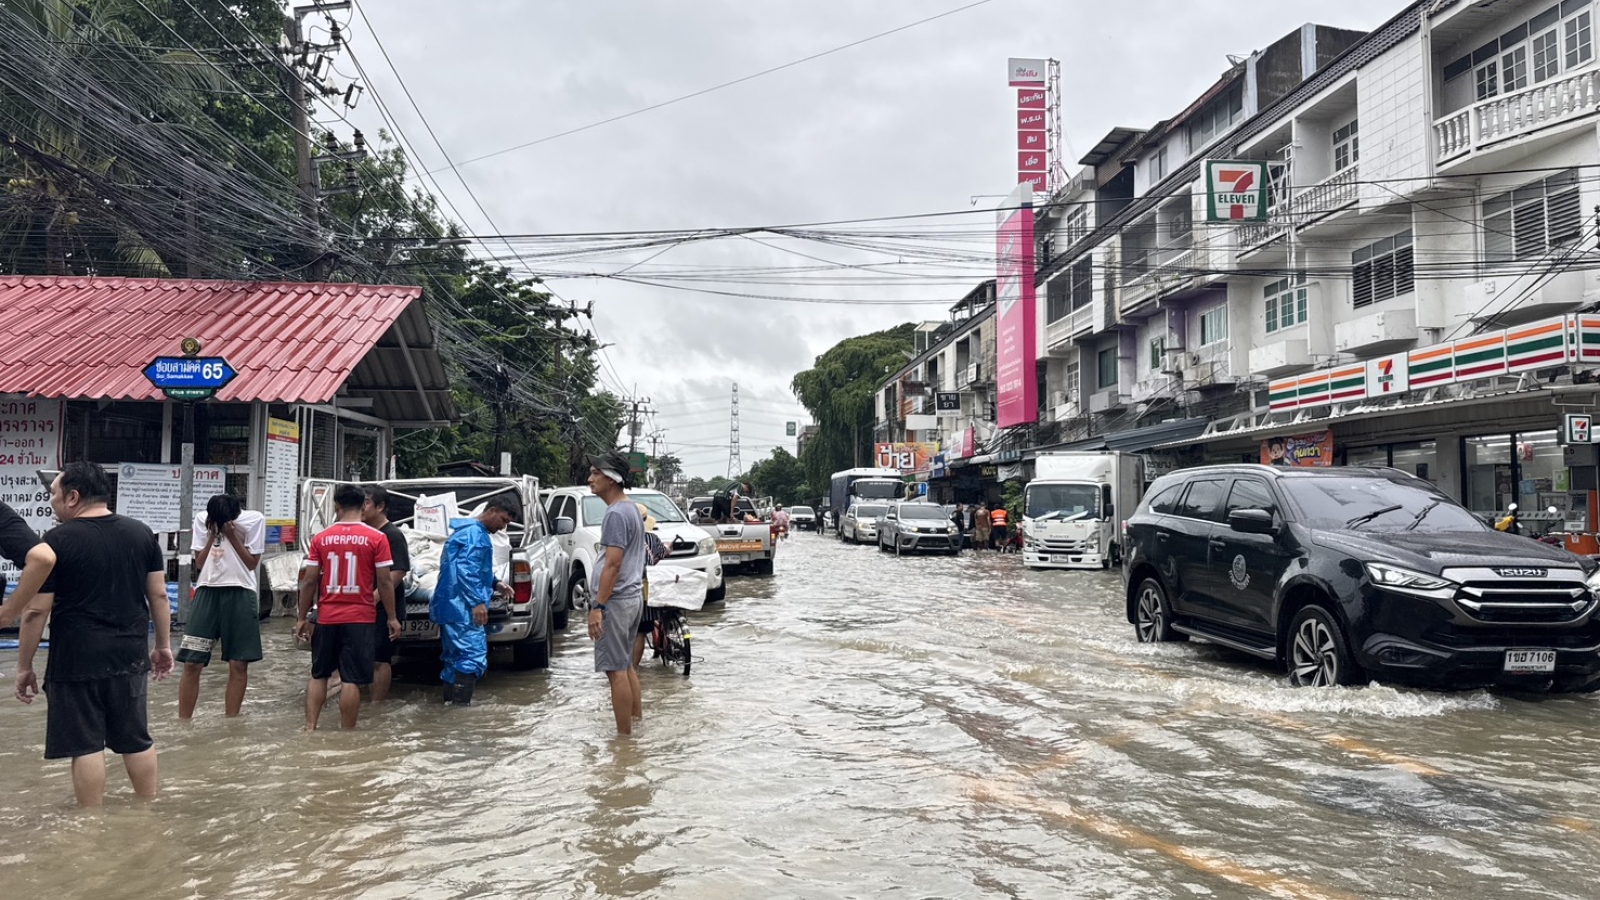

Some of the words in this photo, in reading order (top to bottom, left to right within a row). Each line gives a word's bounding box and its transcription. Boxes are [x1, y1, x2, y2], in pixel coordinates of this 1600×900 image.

[1019, 92, 1043, 103] ประกัน
[1020, 114, 1043, 125] พ.ร.บ.
[1218, 170, 1254, 220] 7
[202, 363, 223, 380] 65
[1378, 358, 1393, 392] 7
[0, 401, 36, 414] ะกาศ
[0, 419, 54, 432] รจราจร
[0, 454, 15, 464] 24
[18, 449, 47, 464] ชั่วโมง
[878, 444, 915, 469] ป้าย
[35, 491, 51, 502] 69
[36, 506, 53, 517] 69
[326, 551, 361, 594] 11
[1499, 568, 1544, 576] ISUZU
[1529, 652, 1554, 663] 7106
